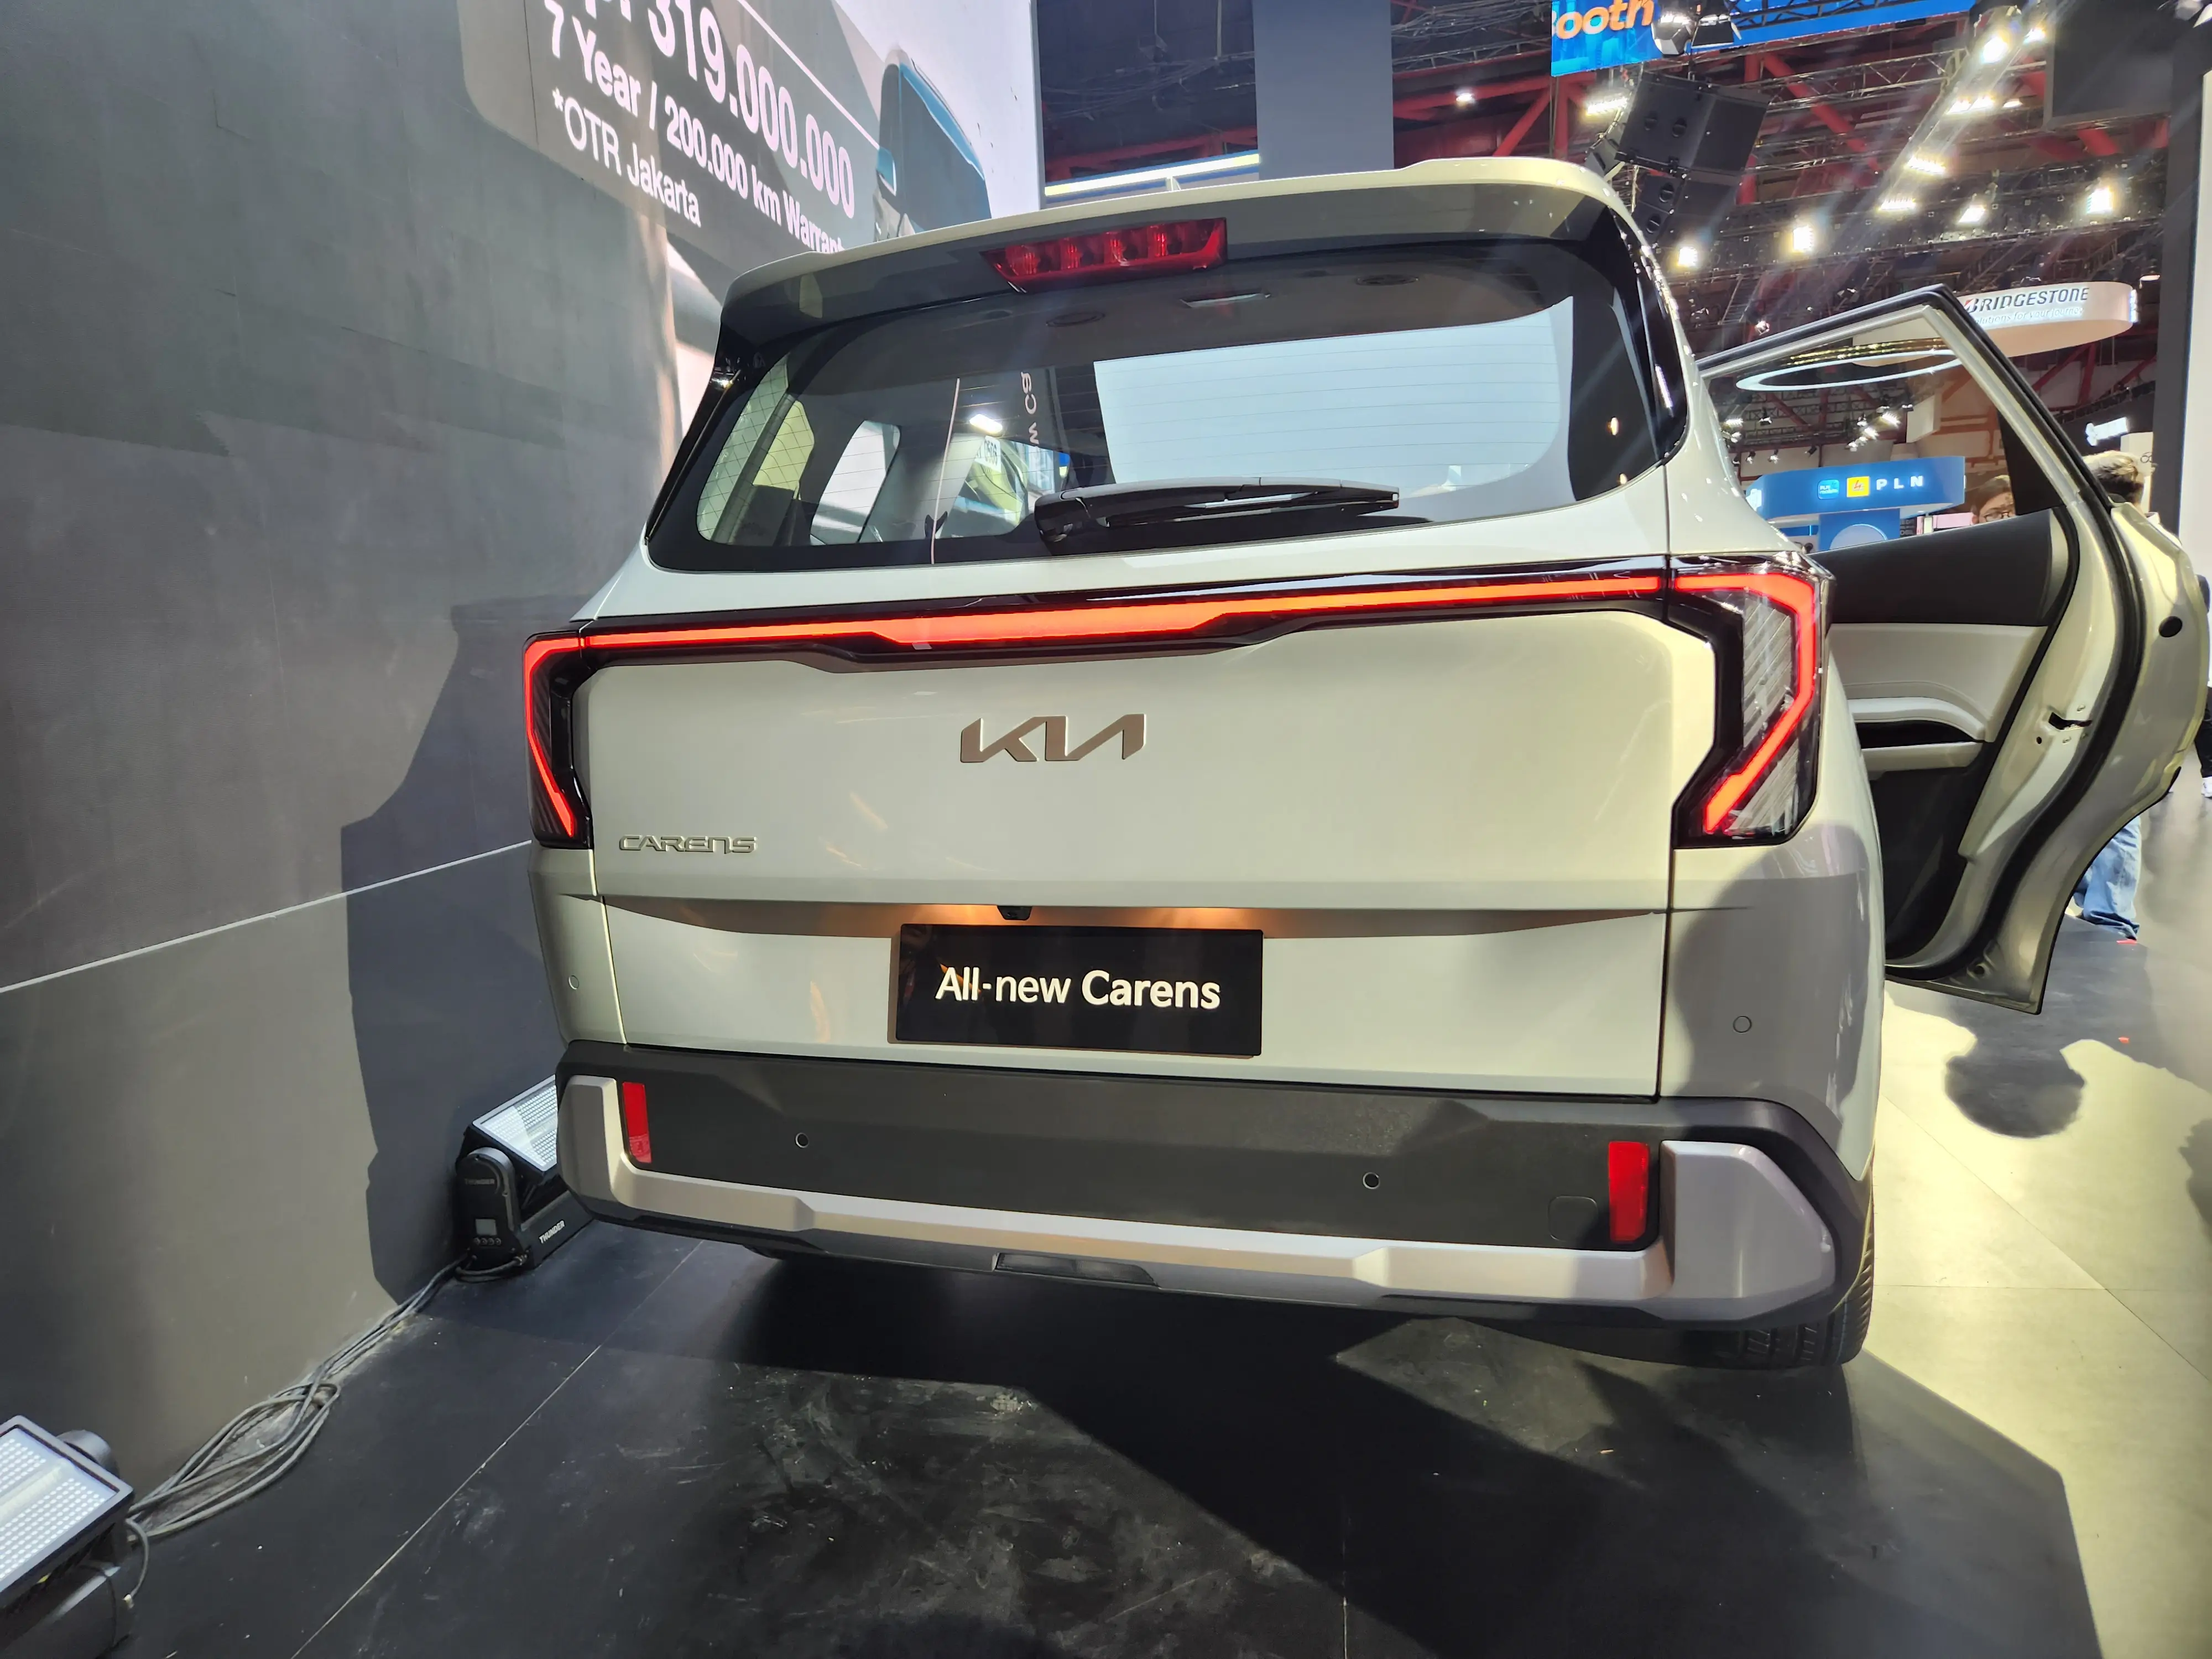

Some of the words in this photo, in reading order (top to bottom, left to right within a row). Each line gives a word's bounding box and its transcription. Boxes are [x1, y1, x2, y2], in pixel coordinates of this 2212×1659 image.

[544, 0, 564, 59] 7
[572, 16, 641, 117] Year
[649, 81, 658, 131] /
[665, 96, 748, 199] 200.000
[751, 165, 781, 226] km
[648, 0, 854, 219] 319.000.000
[627, 143, 701, 227] Jakarta
[1964, 288, 2089, 313] BRIDGESTONE
[1974, 315, 2011, 325] olutions
[2014, 311, 2027, 320] for
[2029, 310, 2050, 319] your
[2051, 306, 2084, 319] journey
[1876, 476, 1923, 491] PLN
[960, 713, 1147, 763] KIA
[619, 834, 757, 854] CARENS
[935, 967, 1071, 1004] All-new
[1082, 969, 1221, 1010] Carens
[539, 1220, 565, 1244] THUNDER
